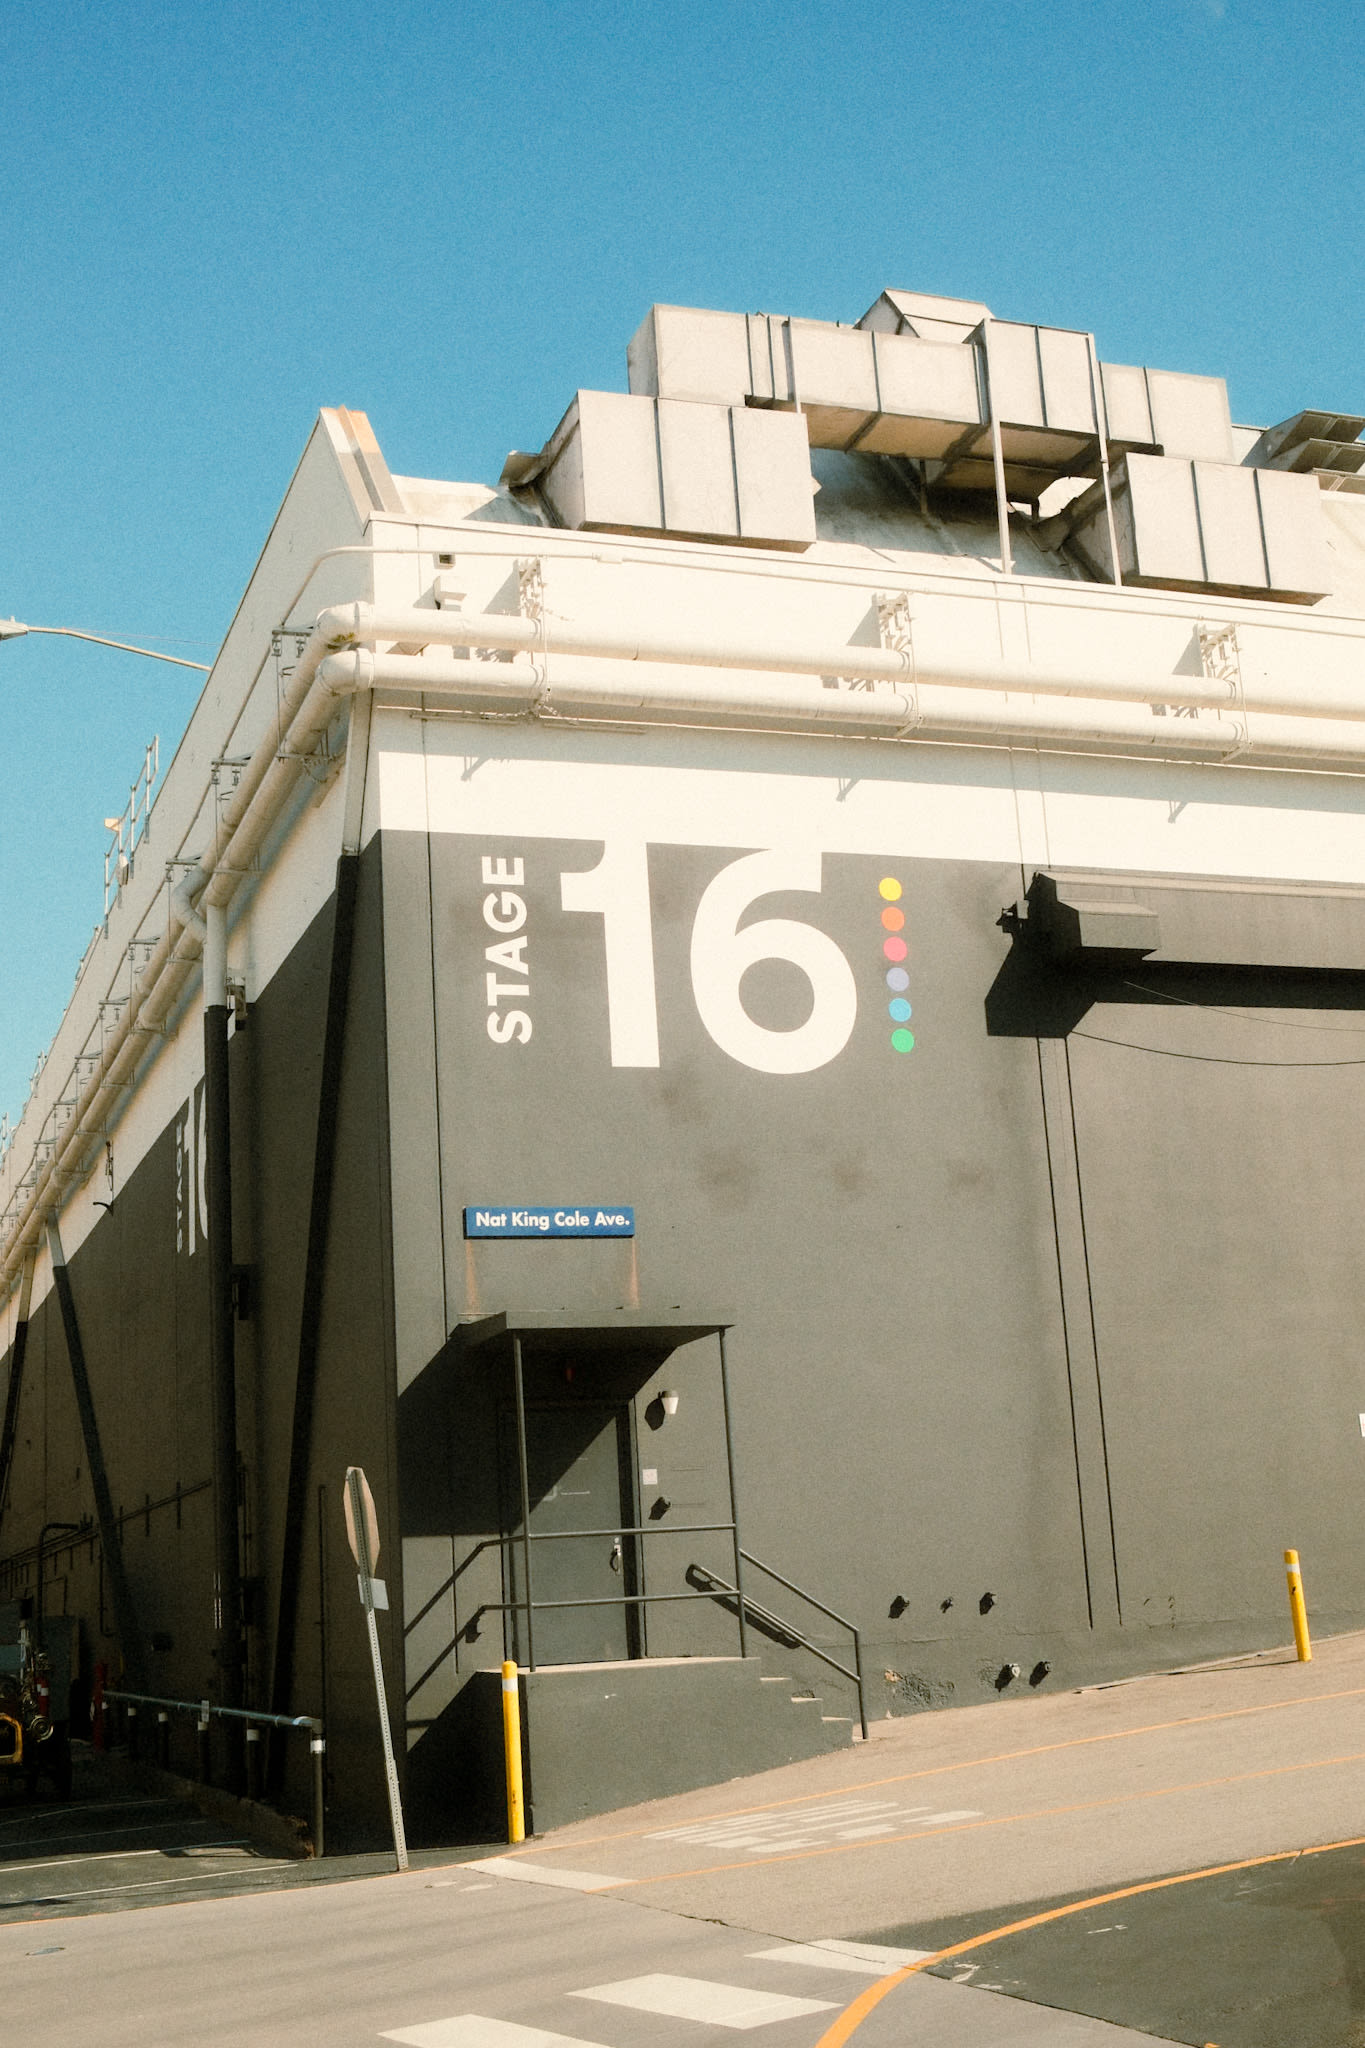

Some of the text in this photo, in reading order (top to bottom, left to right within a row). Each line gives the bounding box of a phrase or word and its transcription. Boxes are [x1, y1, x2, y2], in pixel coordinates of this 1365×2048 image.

[481, 855, 533, 1044] STAGE
[560, 841, 857, 1074] 16
[475, 1210, 630, 1231] Nat King Cole Ave.
